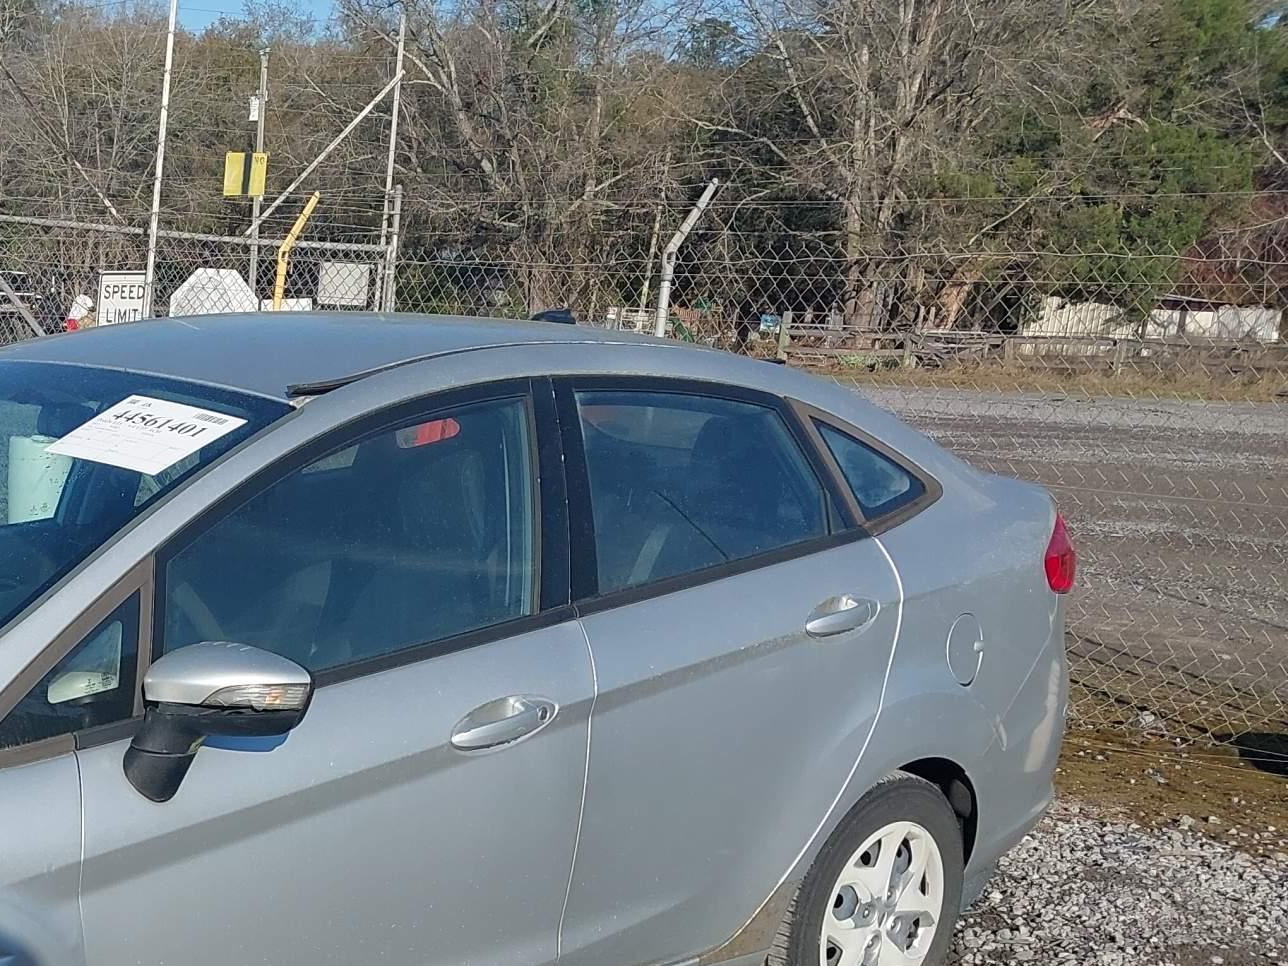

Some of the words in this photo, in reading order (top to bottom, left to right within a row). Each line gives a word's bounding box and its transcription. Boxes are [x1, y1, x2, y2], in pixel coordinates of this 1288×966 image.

[104, 285, 145, 300] SPEED
[106, 308, 139, 324] LIMIT
[112, 409, 208, 438] 44561401
